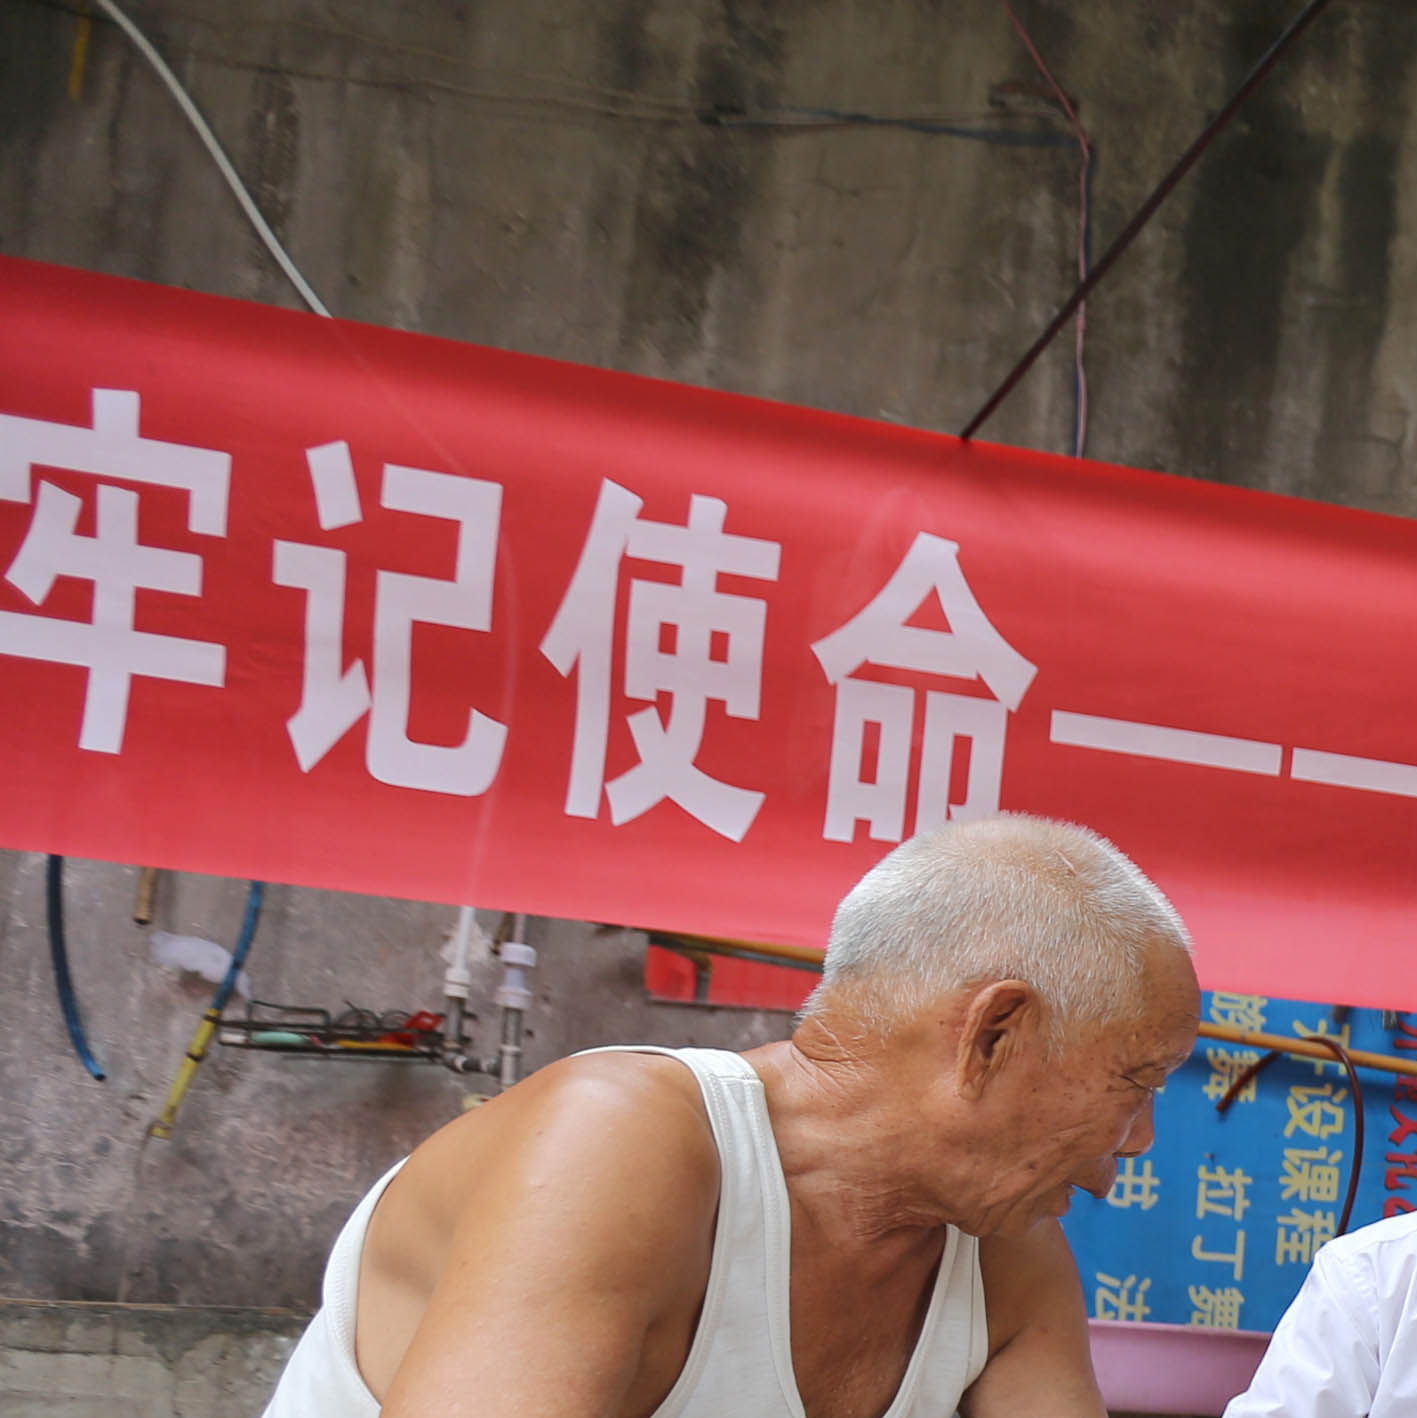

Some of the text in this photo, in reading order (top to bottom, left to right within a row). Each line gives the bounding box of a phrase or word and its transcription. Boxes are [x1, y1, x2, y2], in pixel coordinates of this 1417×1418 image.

[1275, 1018, 1353, 1266] 开设课程
[1188, 1164, 1253, 1329] 拉丁舞
